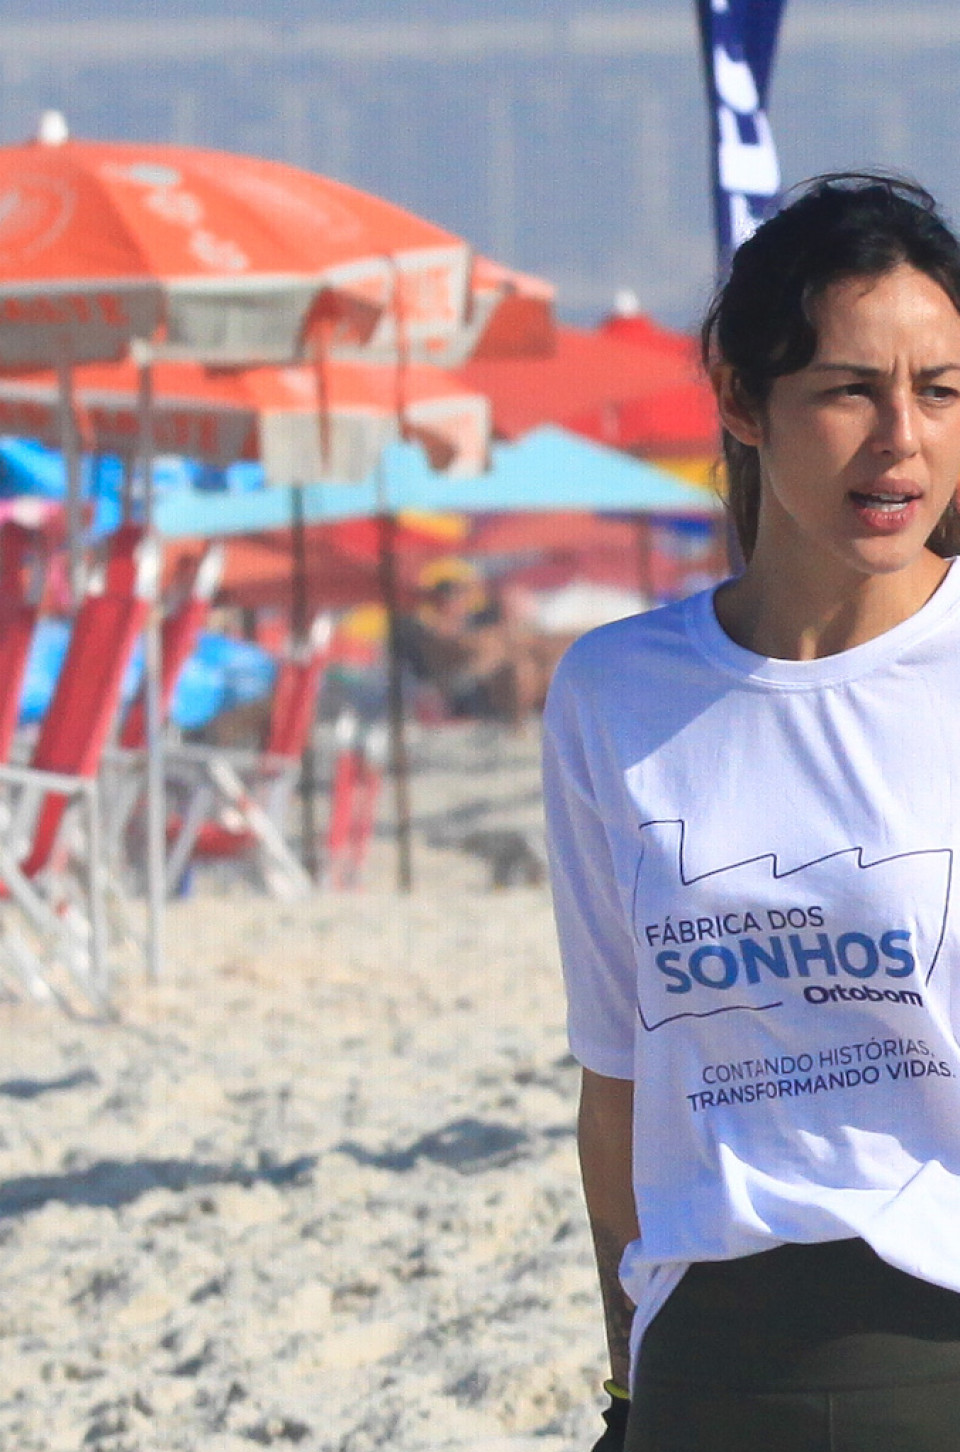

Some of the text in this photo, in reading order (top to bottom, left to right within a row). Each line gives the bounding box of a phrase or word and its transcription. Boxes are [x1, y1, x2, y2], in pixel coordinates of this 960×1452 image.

[646, 905, 825, 946] FÁBRICA DOS
[656, 931, 915, 994] SONHOS
[803, 986, 924, 1007] Ortobom
[686, 1066, 881, 1112] TRANSFORMANDO
[702, 1054, 814, 1085] CONTANDO
